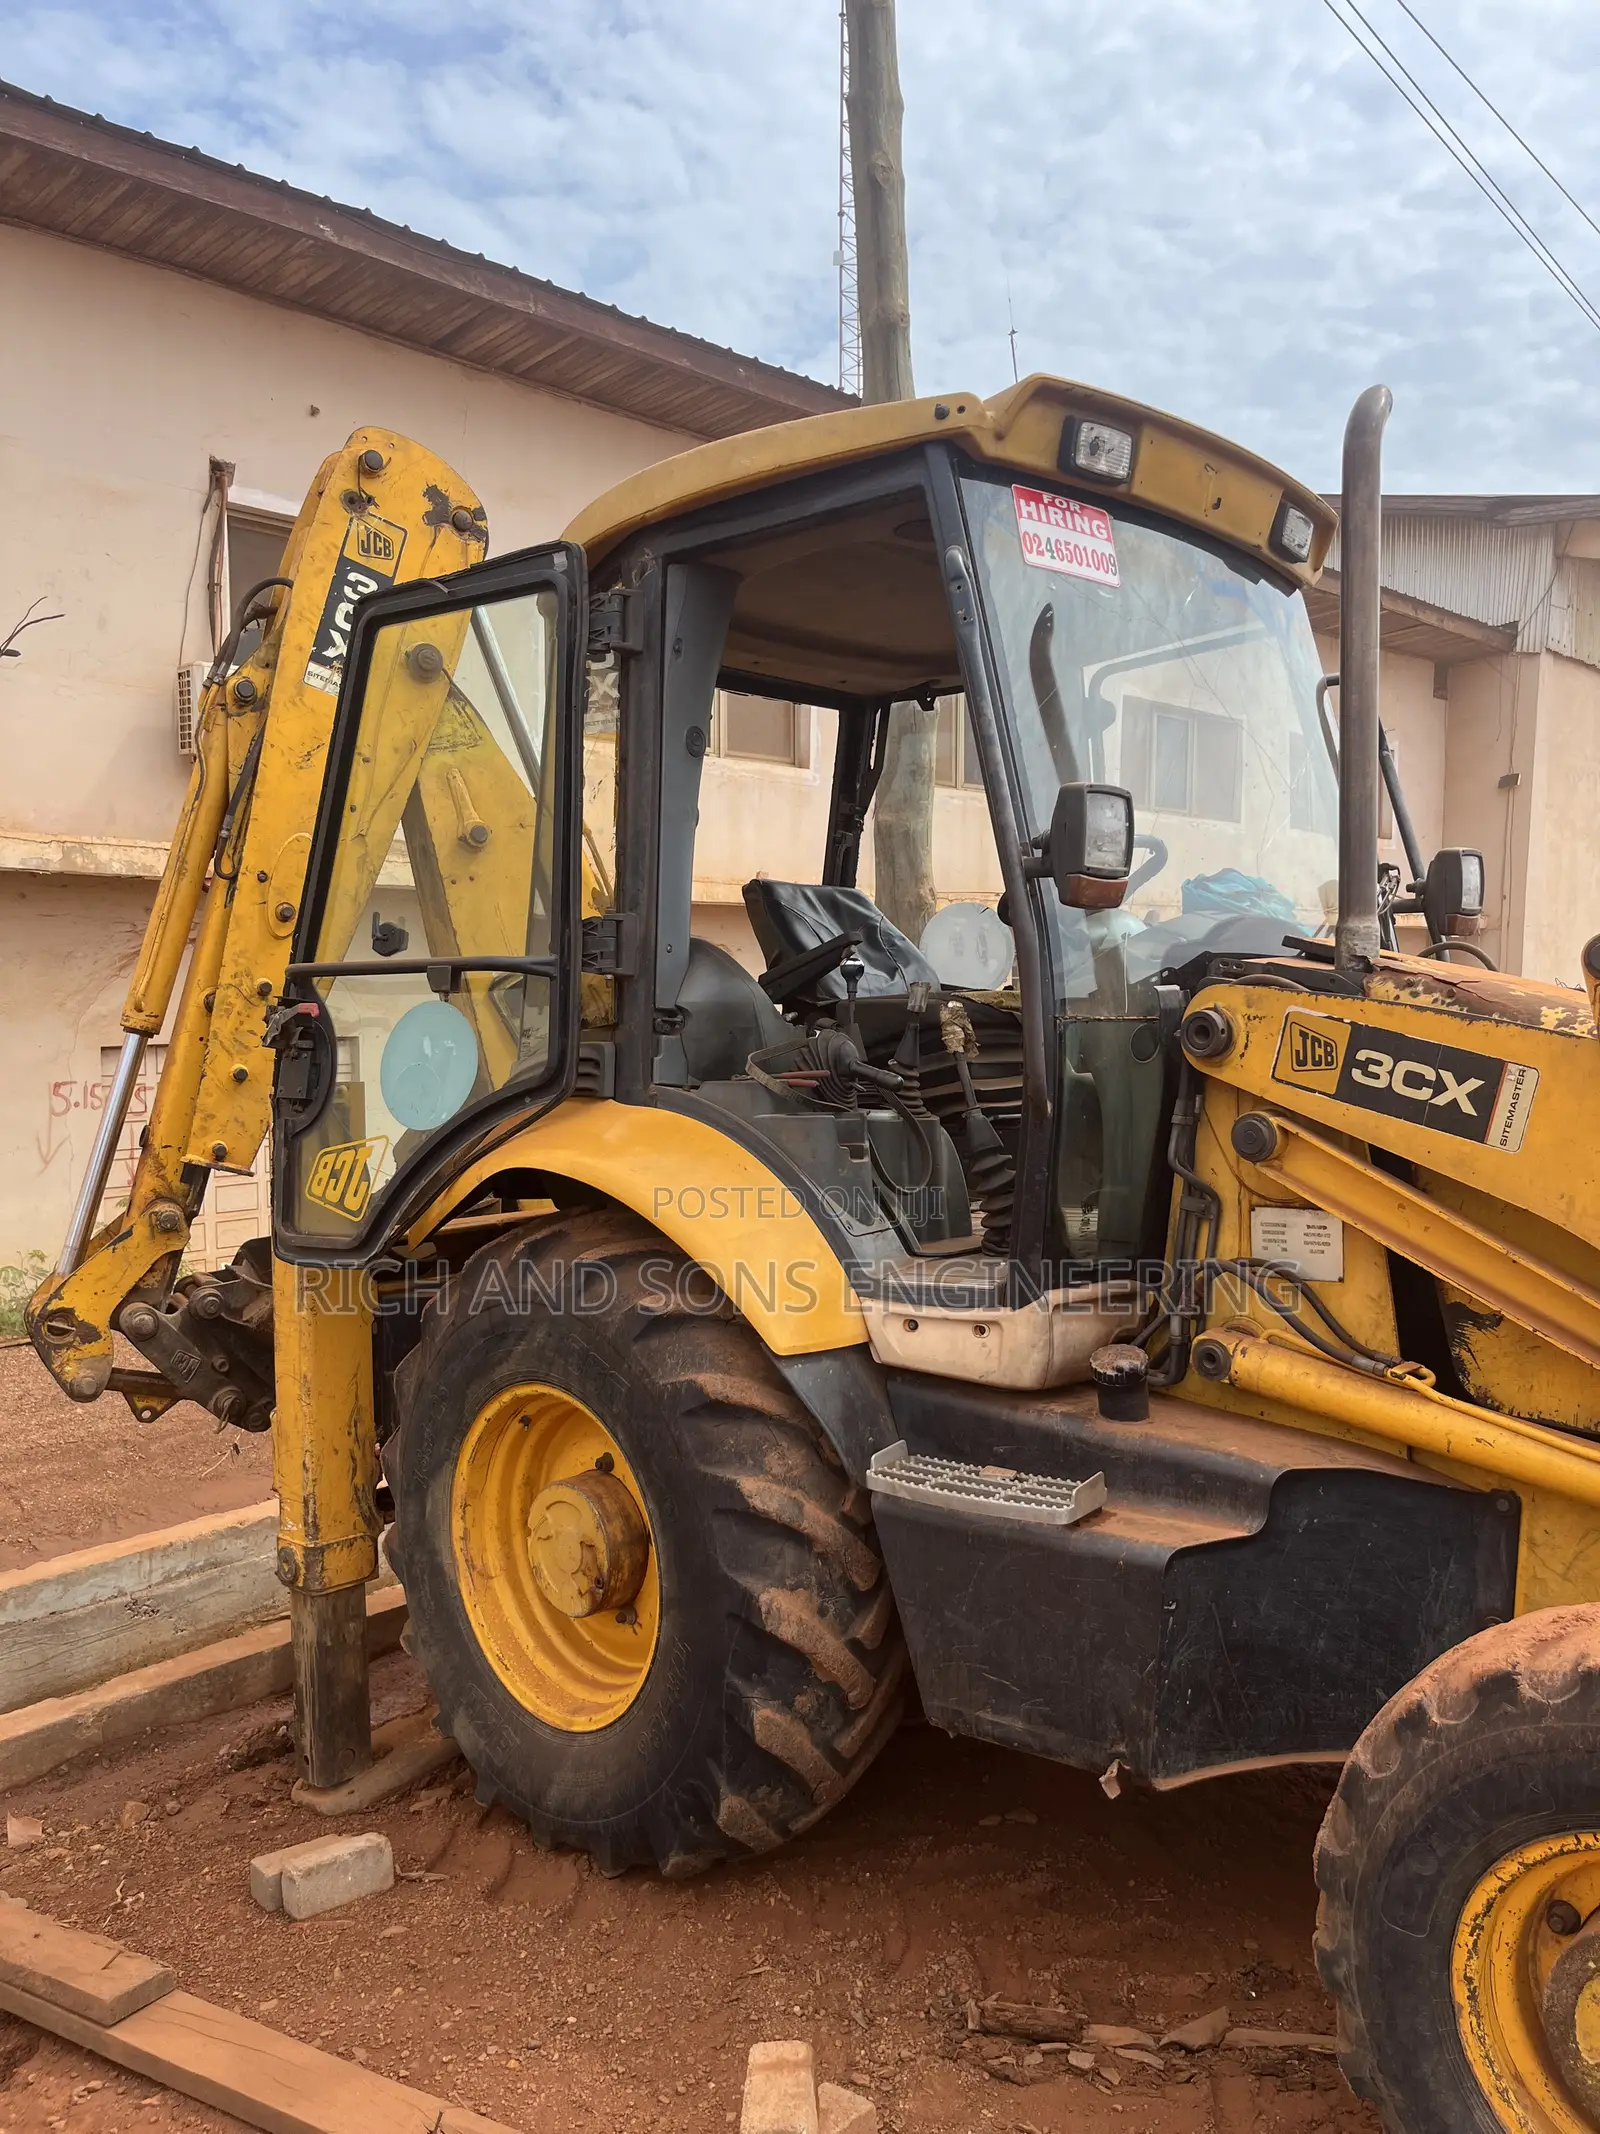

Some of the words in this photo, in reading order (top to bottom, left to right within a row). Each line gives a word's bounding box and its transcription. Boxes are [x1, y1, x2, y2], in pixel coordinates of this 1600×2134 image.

[1020, 499, 1107, 539] HIRING
[1043, 494, 1081, 513] FOR
[360, 526, 393, 558] JCB
[1022, 531, 1118, 577] 0246501009
[1294, 1028, 1335, 1068] JCB
[1351, 1049, 1486, 1117] 3CX
[1499, 1066, 1527, 1147] SITEMASTER
